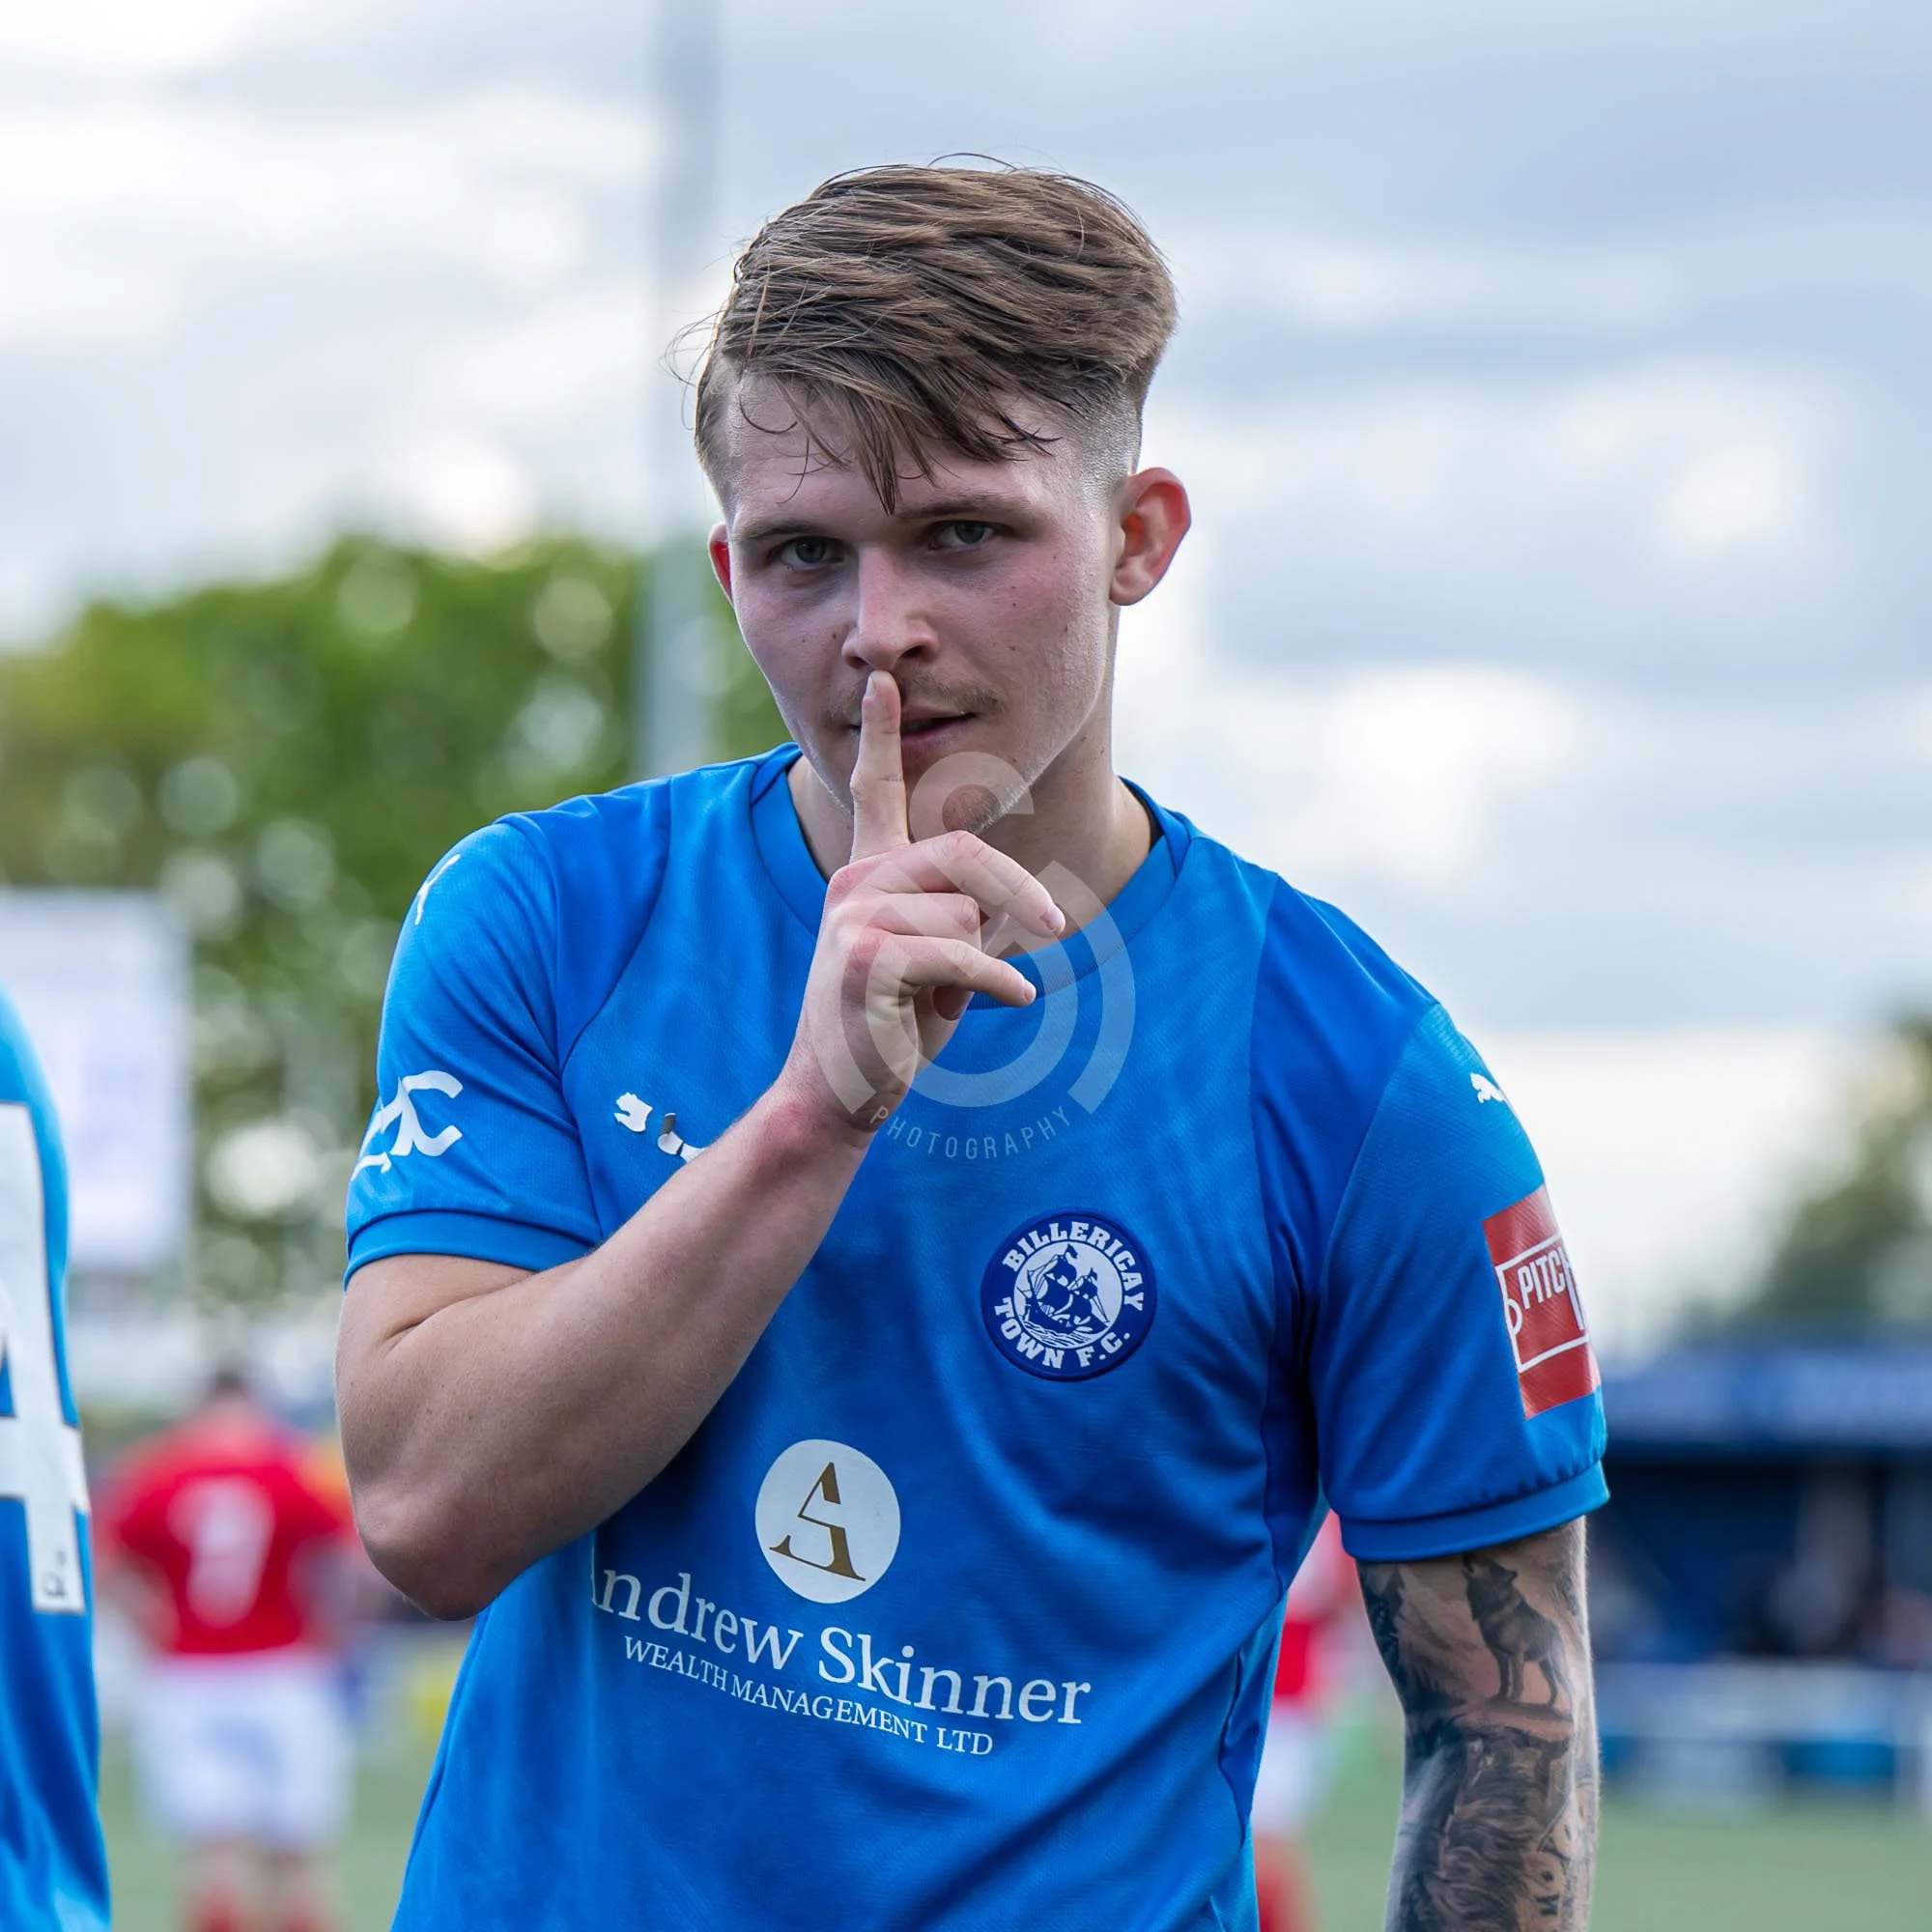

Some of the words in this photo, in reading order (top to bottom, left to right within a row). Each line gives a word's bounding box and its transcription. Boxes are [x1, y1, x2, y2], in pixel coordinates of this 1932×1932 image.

[1002, 1221, 1145, 1312] BILLERICAY
[994, 1296, 1065, 1370] TOWN
[1075, 1331, 1131, 1368] F.C.
[591, 1569, 804, 1670] ndrew
[818, 1626, 1092, 1724] Skinner
[624, 1635, 727, 1691] WEALTH
[730, 1674, 928, 1744] MANAGEMENT
[935, 1726, 995, 1756] LTD
